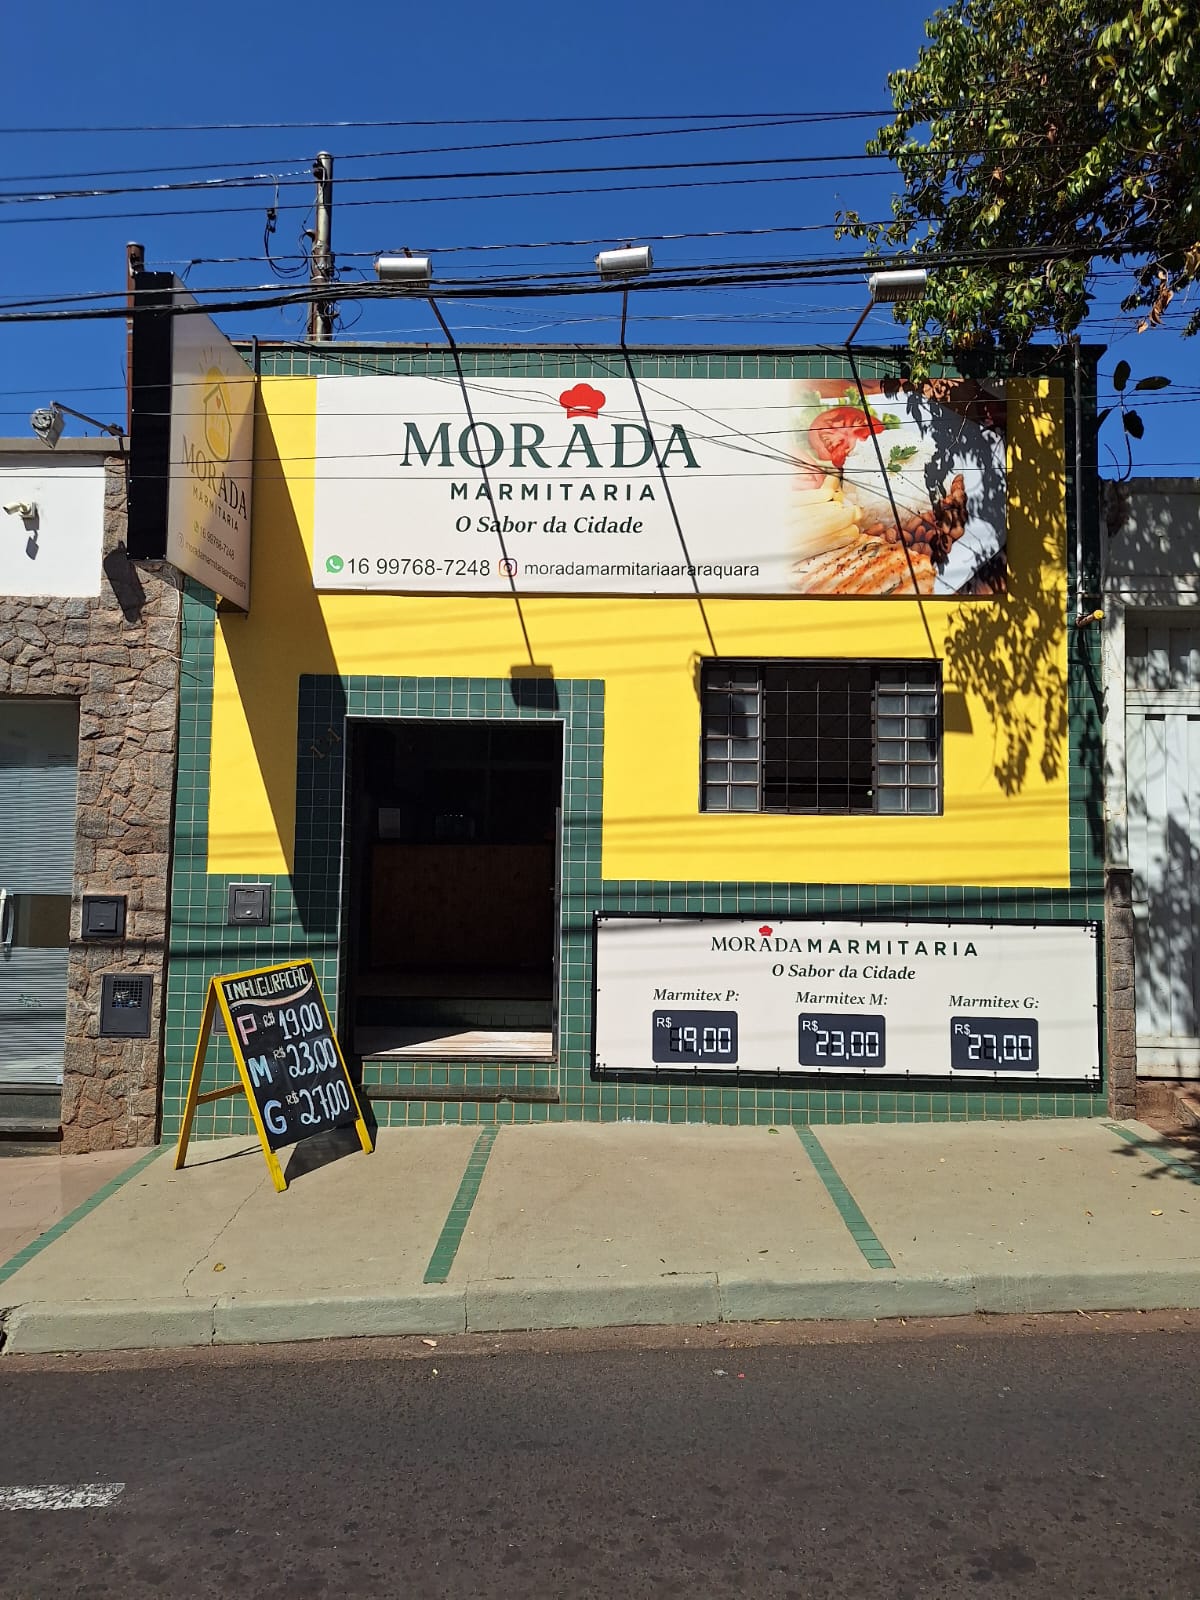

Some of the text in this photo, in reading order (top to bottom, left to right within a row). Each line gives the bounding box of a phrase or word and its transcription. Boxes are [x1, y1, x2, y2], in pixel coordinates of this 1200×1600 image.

[400, 421, 702, 470] MORADA
[181, 433, 248, 521] MORADA
[450, 482, 656, 502] MARMITARIA
[192, 485, 239, 533] MARMITARIA
[455, 515, 644, 535] O Sabor da Cidade
[347, 557, 491, 577] 16 99768-7248
[524, 561, 760, 580] moradamarmitariaararaquara
[711, 936, 978, 957] MORADA MARMITARIA
[772, 964, 916, 980] O Sabor da Cidade
[653, 988, 740, 1002] Marmitex P:
[795, 991, 888, 1007] Marmitex M:
[948, 995, 1040, 1010] Marmitex G:
[278, 1001, 324, 1041] 19,00
[656, 1017, 732, 1057] R$ 19,00
[802, 1020, 879, 1061] R$ 23,00
[954, 1023, 1032, 1064] R$ 27,00
[286, 1037, 338, 1079] 23,00
[299, 1079, 351, 1126] 27,00
